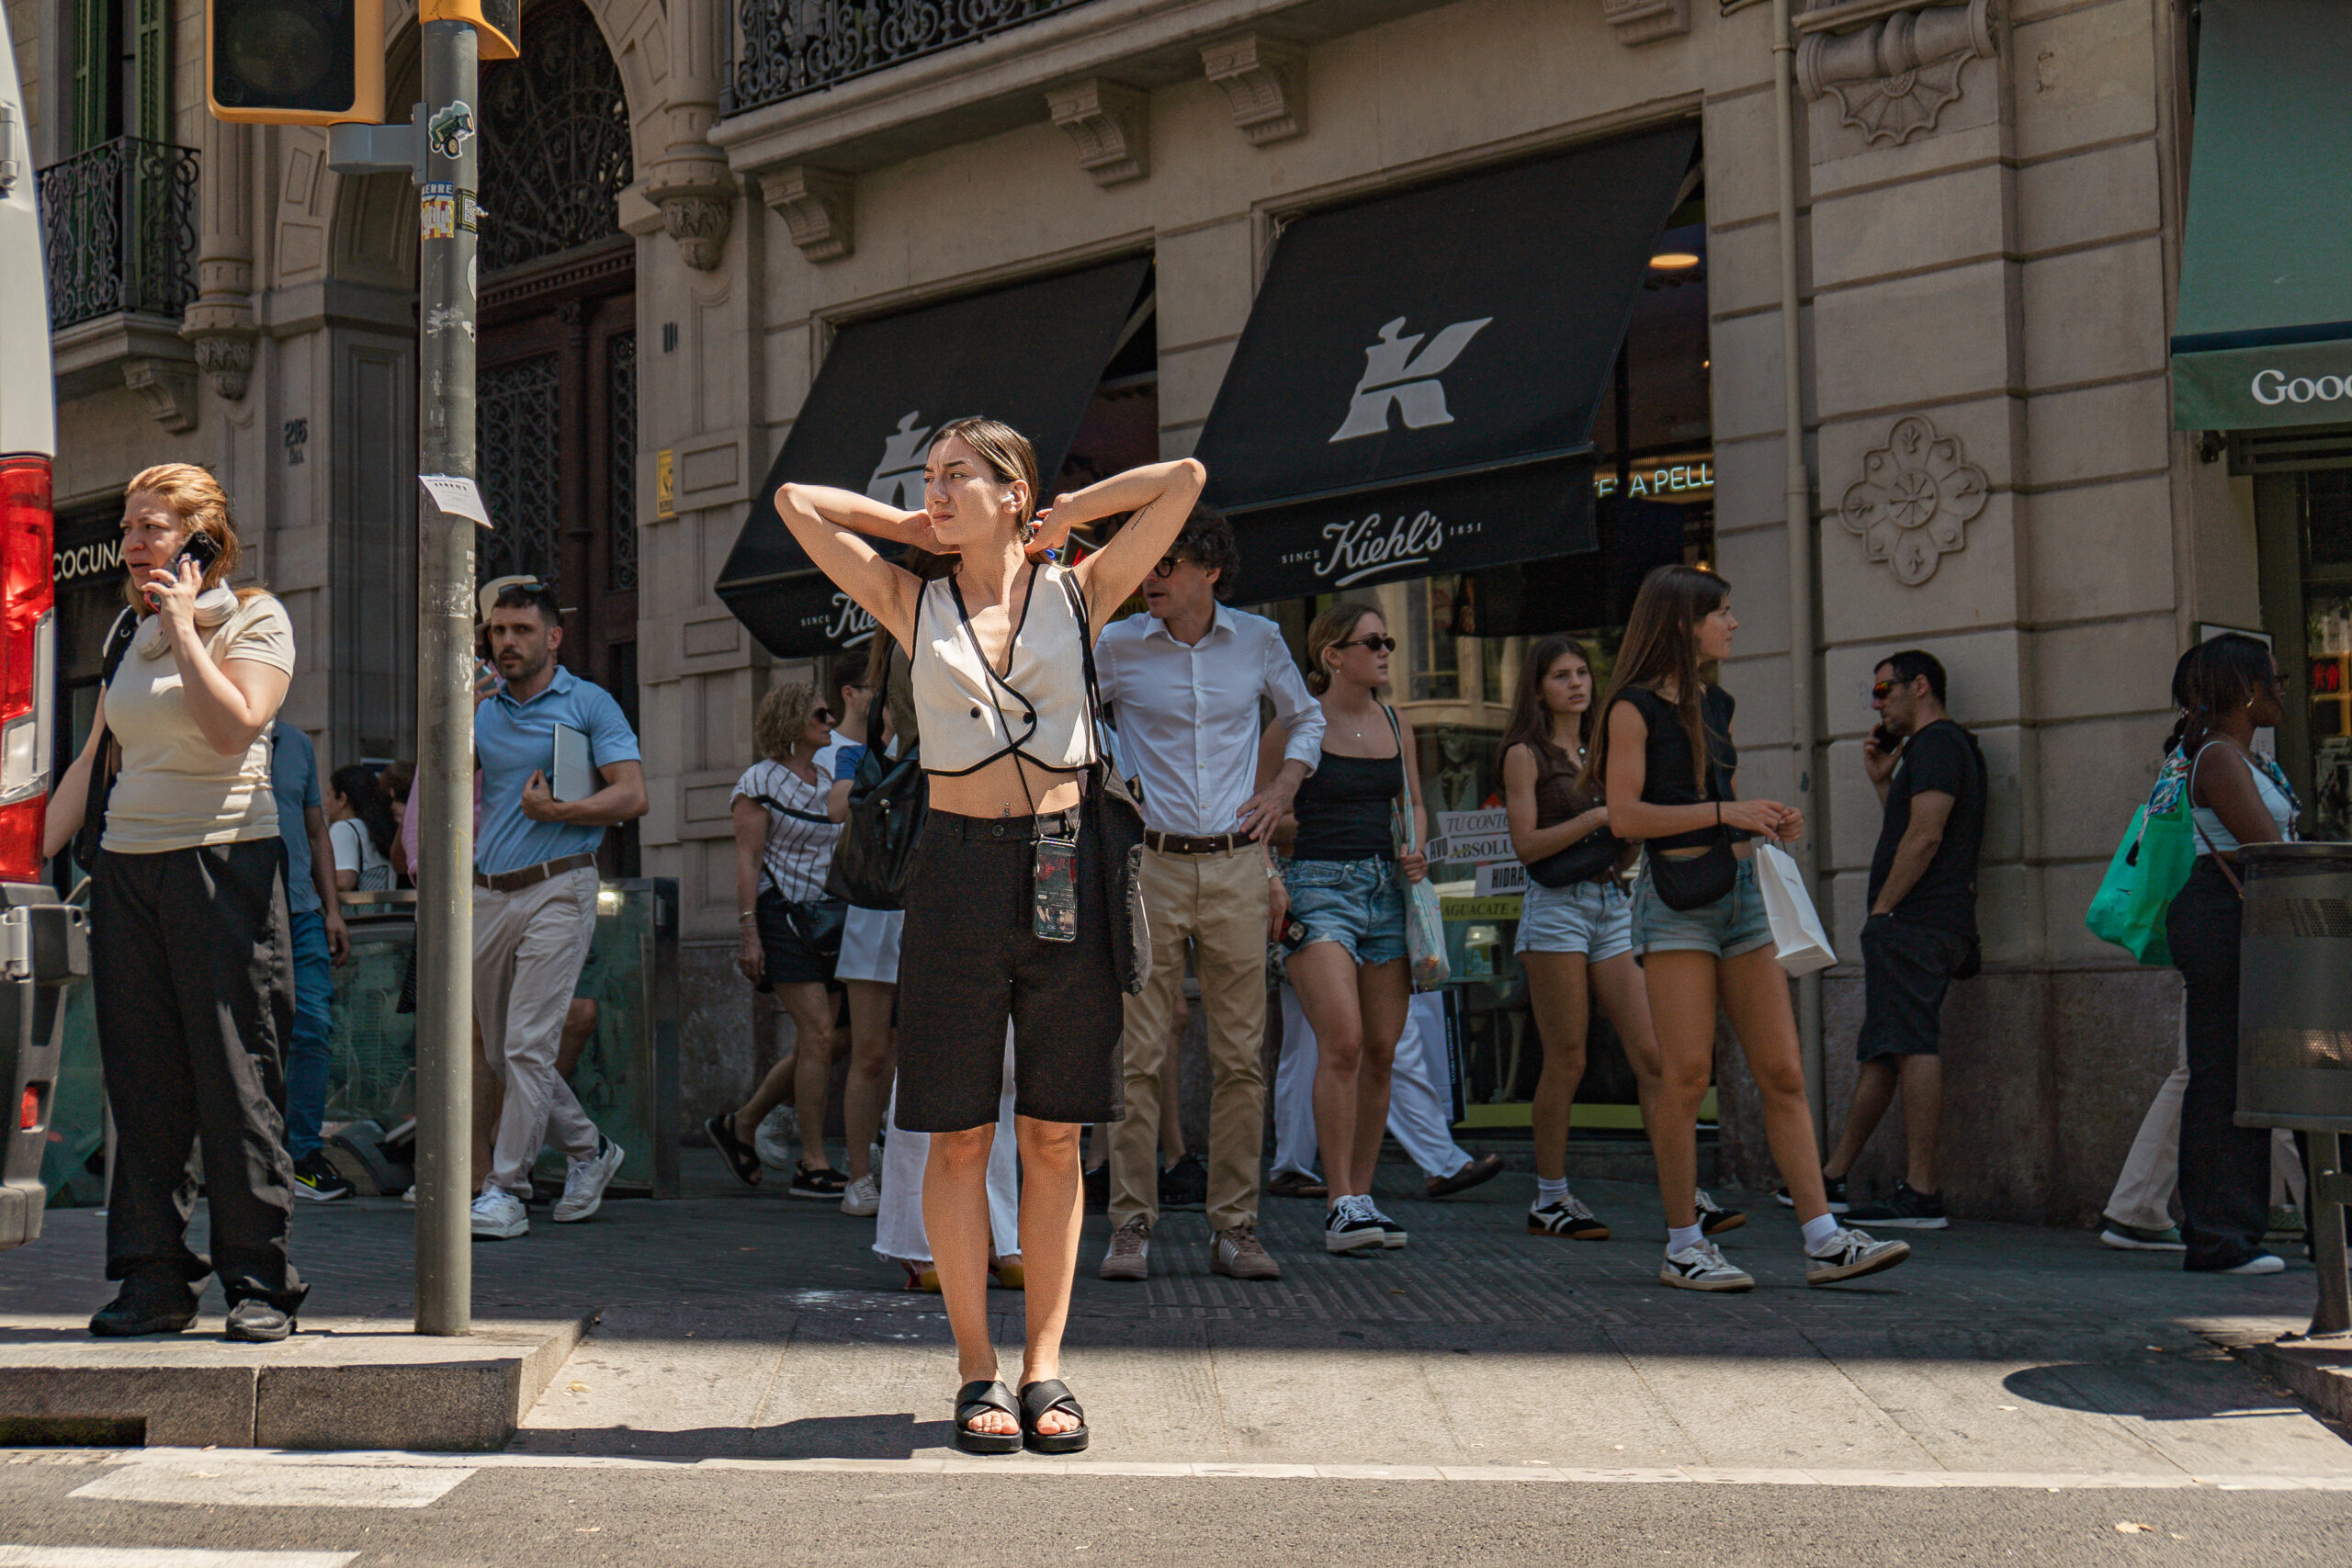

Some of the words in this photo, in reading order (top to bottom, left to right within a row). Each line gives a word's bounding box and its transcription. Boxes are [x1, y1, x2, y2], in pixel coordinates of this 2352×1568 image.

[1282, 549, 1320, 564] SINCE
[1314, 511, 1443, 577] Kiehl's
[1450, 522, 1482, 536] 1851
[801, 614, 831, 626] SINCE
[1447, 817, 1466, 832] TU
[1444, 902, 1509, 916] AGUACATE
